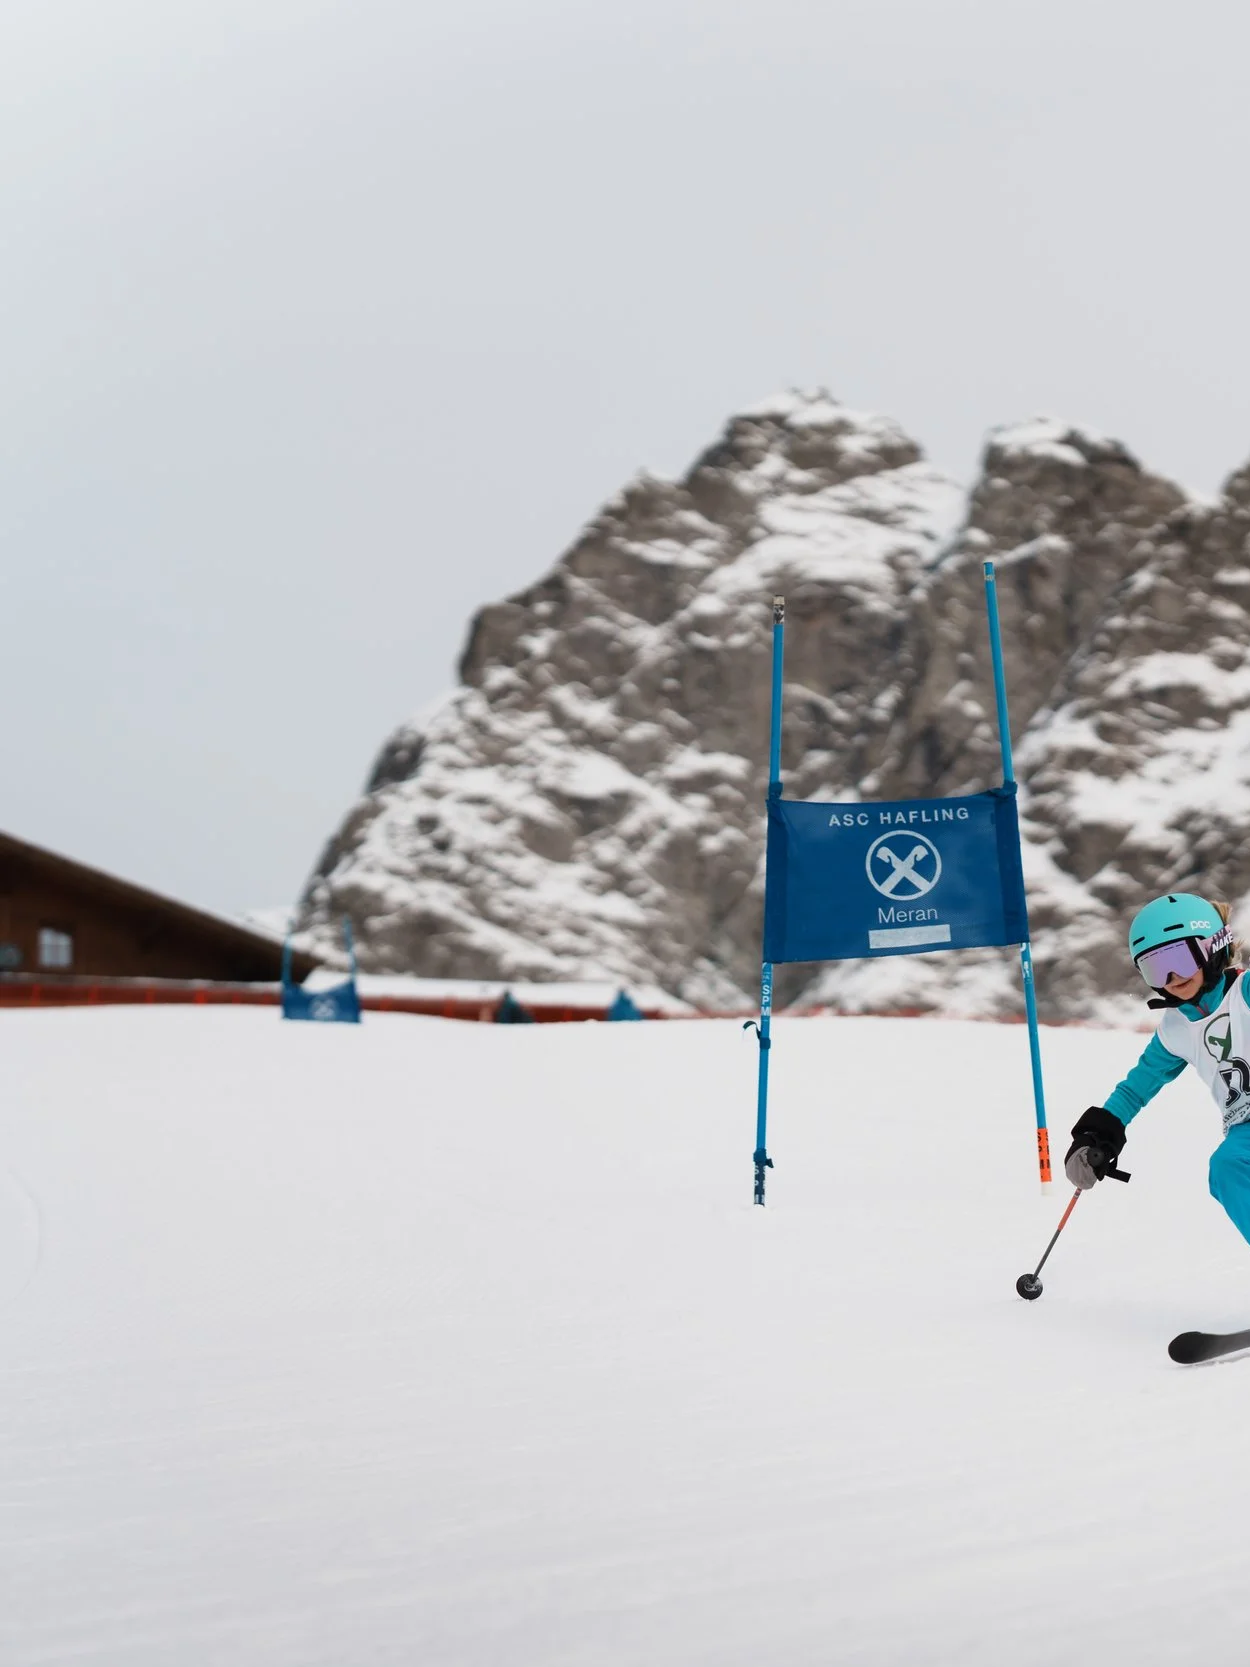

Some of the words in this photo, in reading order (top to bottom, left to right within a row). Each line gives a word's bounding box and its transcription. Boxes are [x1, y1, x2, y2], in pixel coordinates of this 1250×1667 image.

[829, 813, 869, 827] ASC
[880, 807, 969, 825] HAFLING
[878, 907, 939, 924] Meran
